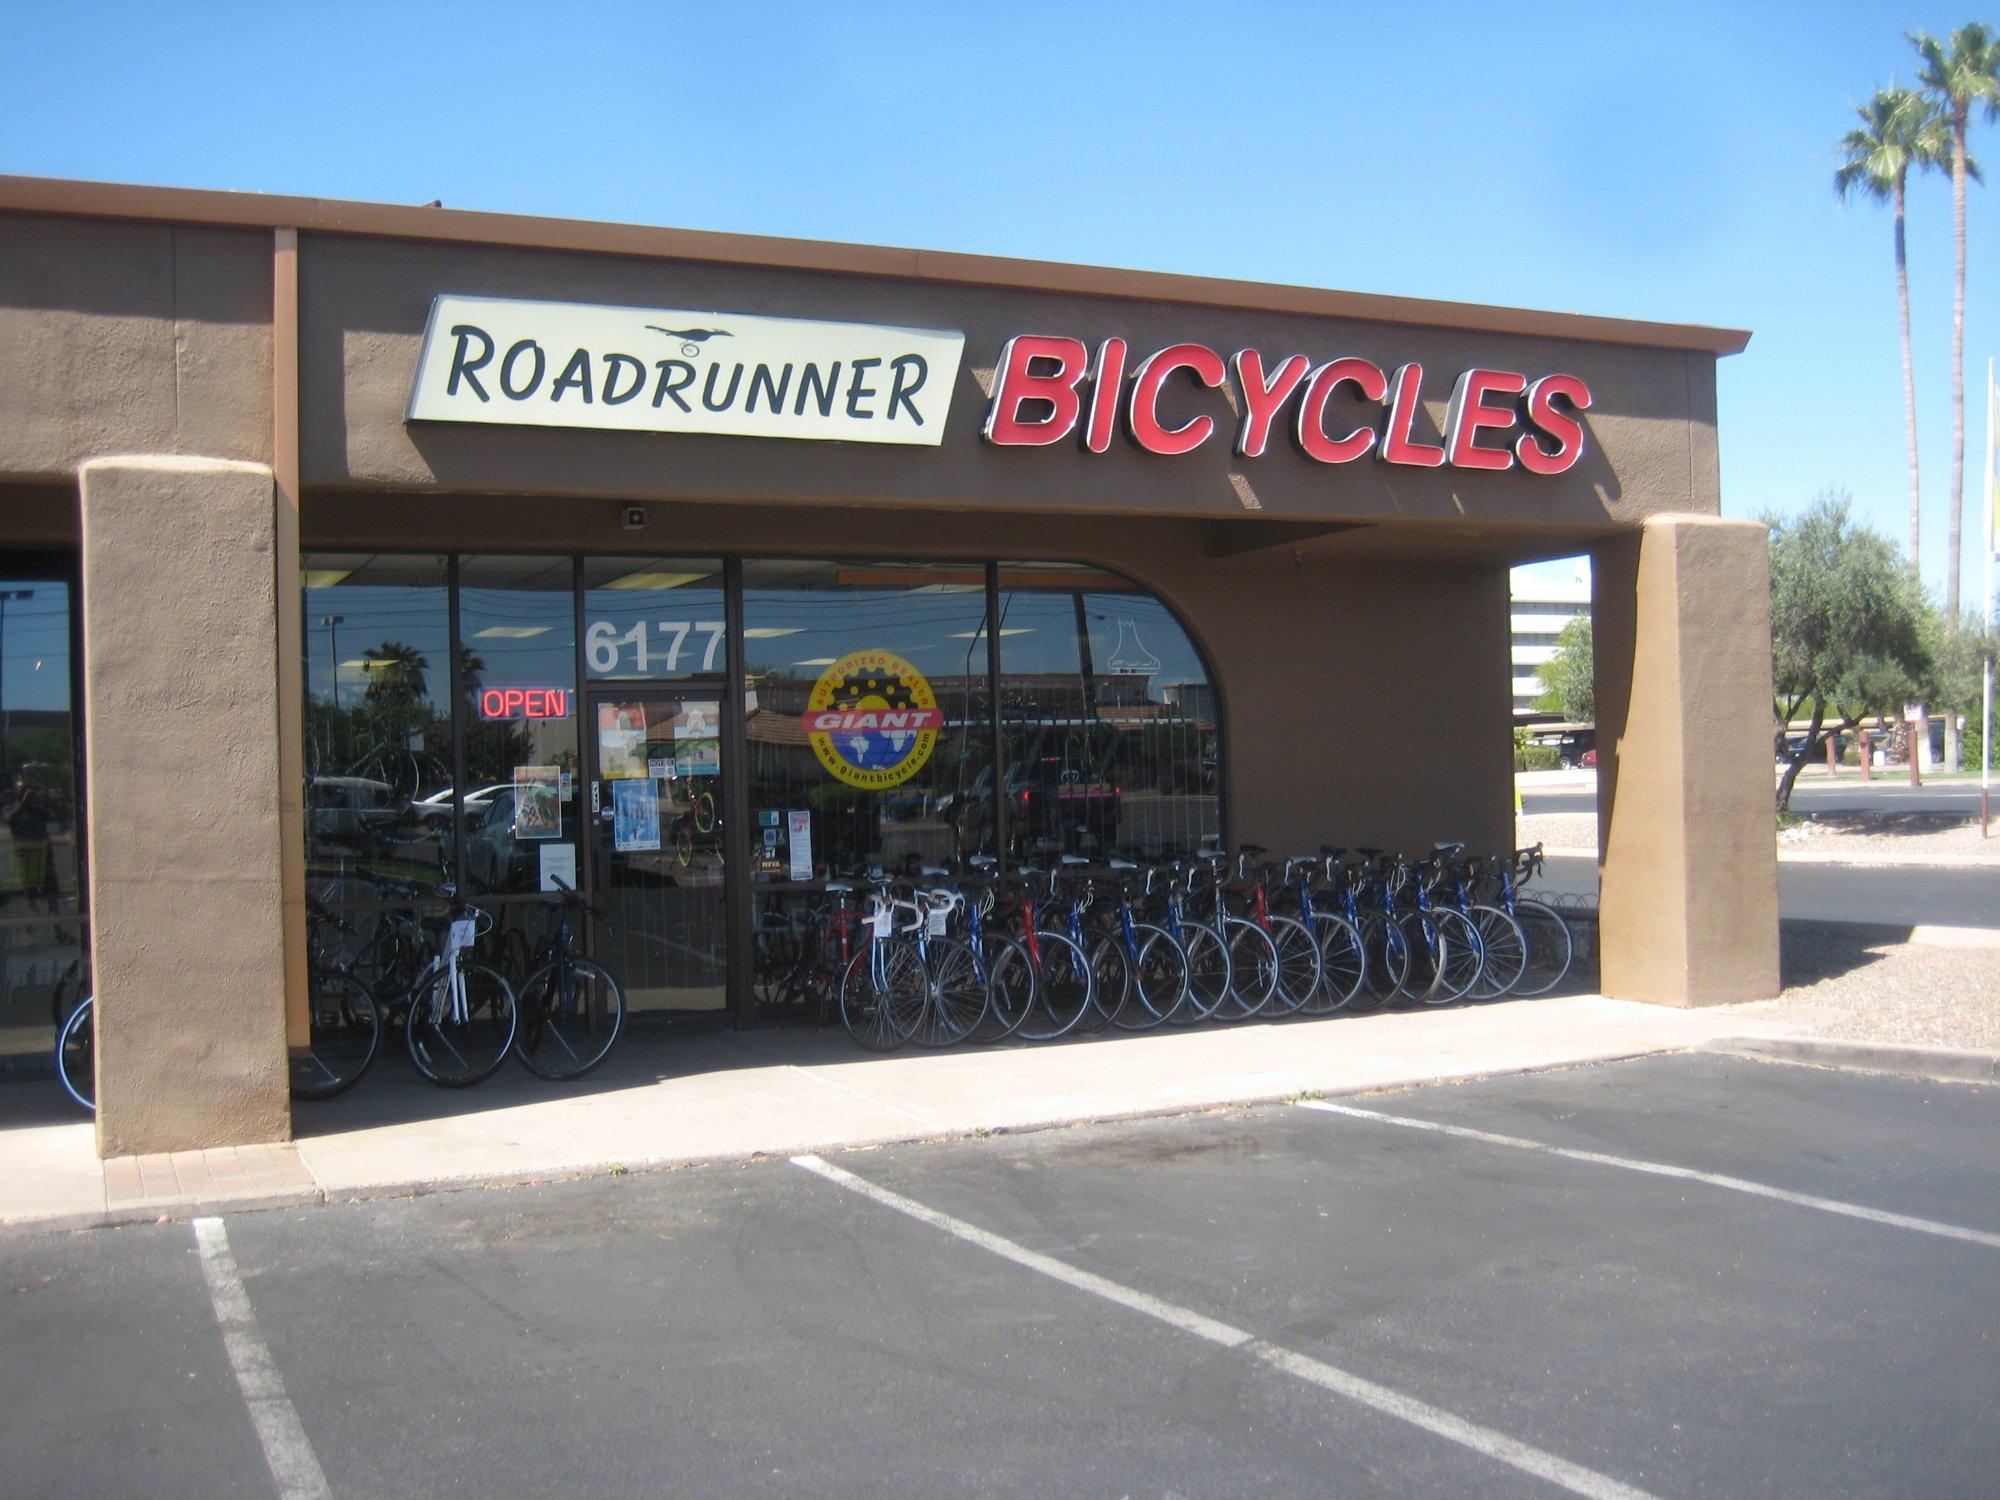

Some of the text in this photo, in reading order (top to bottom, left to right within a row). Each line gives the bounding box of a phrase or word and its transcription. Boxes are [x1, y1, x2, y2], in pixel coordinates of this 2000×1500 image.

[446, 324, 929, 426] ROADRUNNER
[983, 333, 1593, 476] BICYCLES
[586, 620, 726, 673] 6177
[482, 689, 566, 718] OPEN
[817, 656, 929, 706] AUTHORIZED DEALER
[814, 712, 933, 730] GIANT
[818, 732, 931, 783] www.giantbicycle.com
